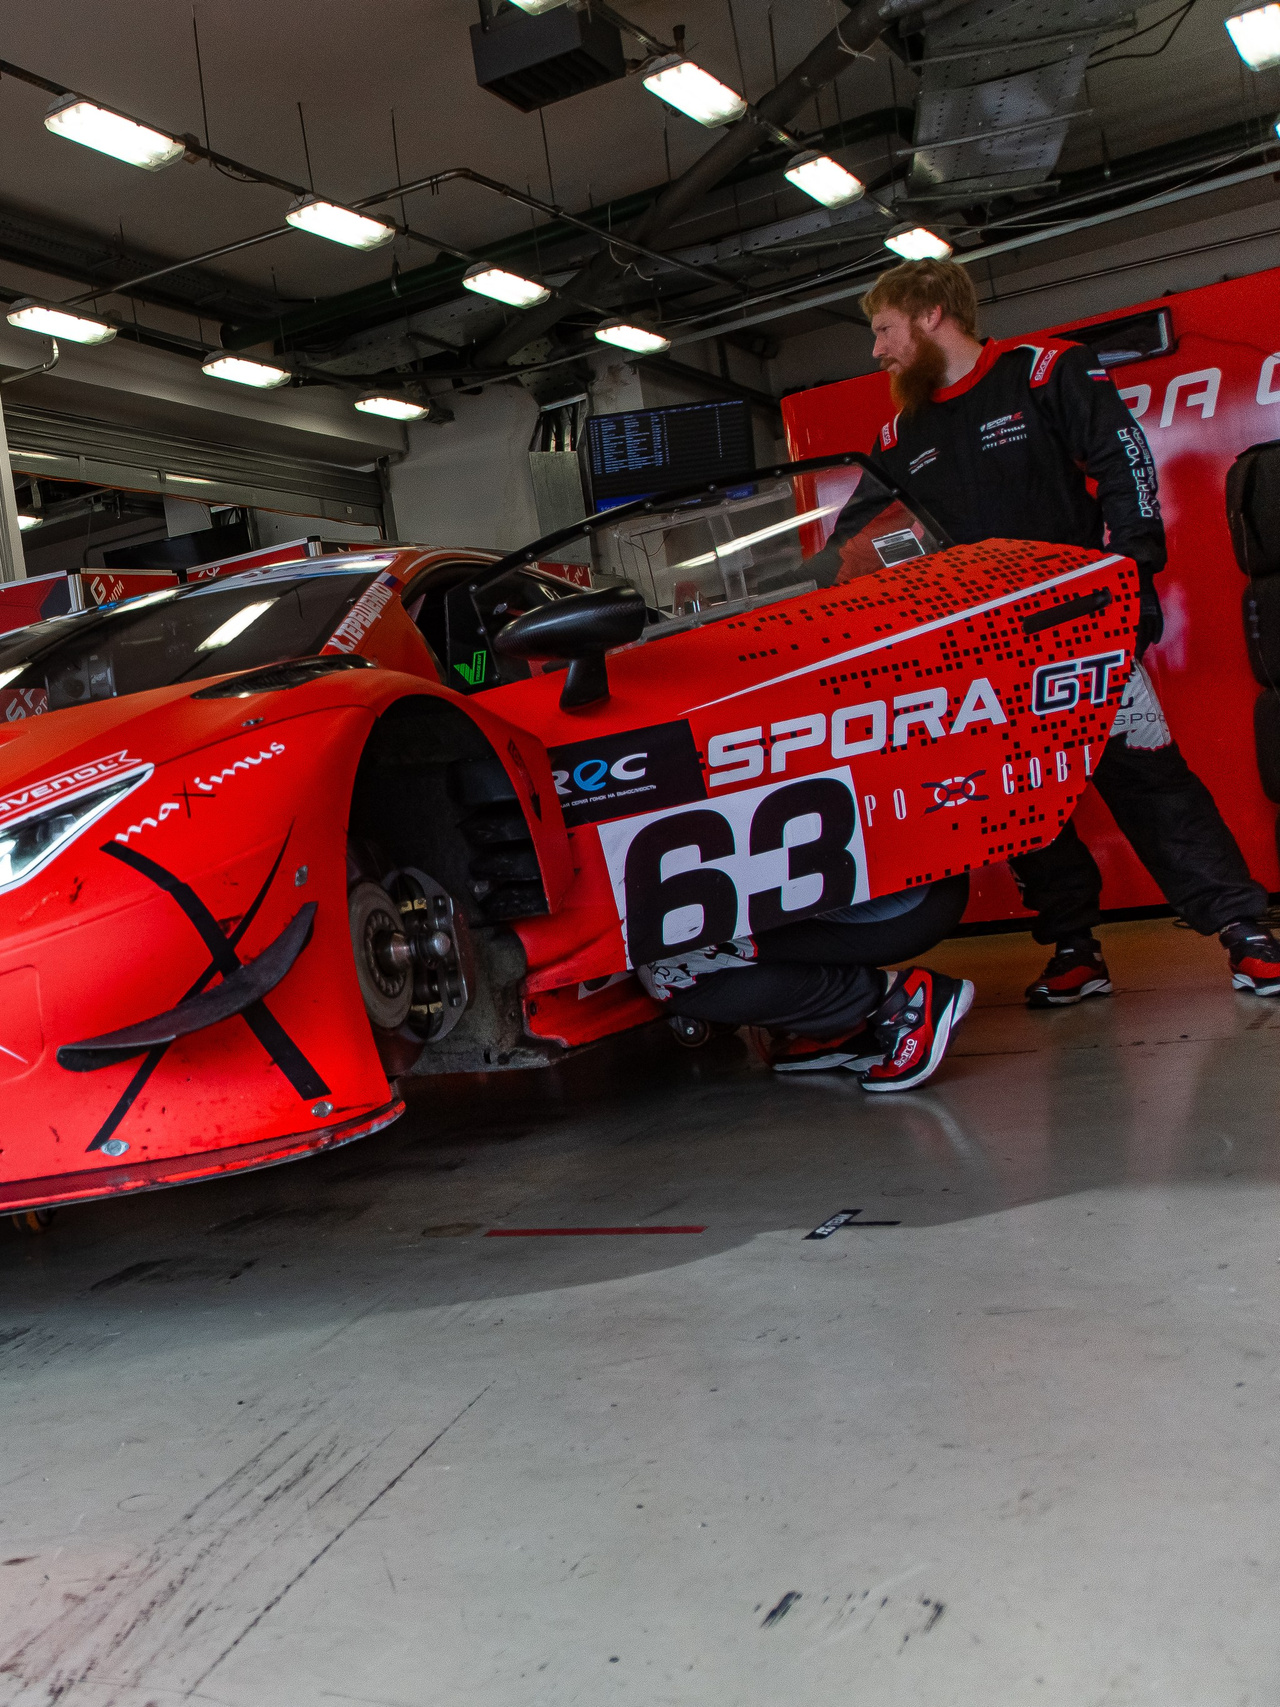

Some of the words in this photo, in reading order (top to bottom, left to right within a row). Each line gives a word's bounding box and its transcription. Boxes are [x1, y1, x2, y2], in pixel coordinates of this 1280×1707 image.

[1117, 427, 1140, 467] YOUR
[1130, 426, 1152, 465] HISTORY
[1132, 467, 1154, 518] CREATE
[707, 677, 1008, 788] SPORA
[1031, 648, 1125, 717] GT
[571, 798, 588, 807] СЕРИЯ
[589, 794, 607, 803] ГОНОК
[616, 784, 657, 797] ВЫНОСЛИВОСТЬ
[623, 777, 858, 970] 63
